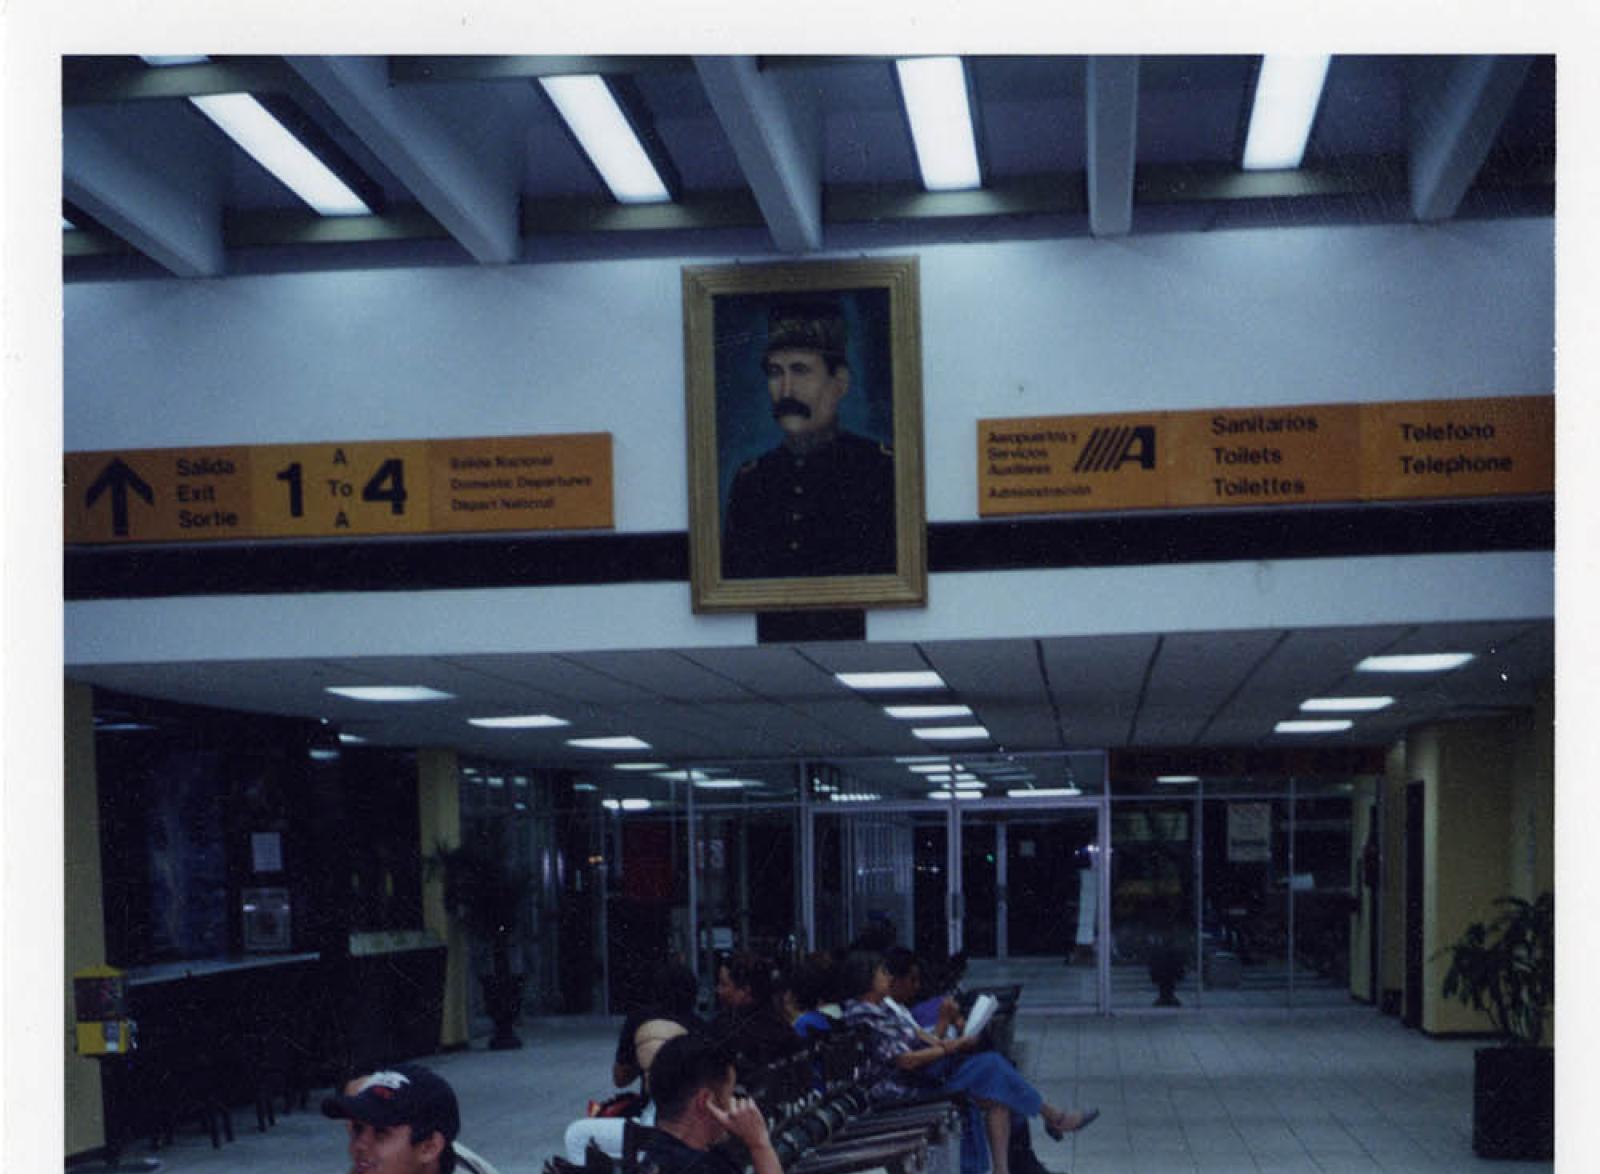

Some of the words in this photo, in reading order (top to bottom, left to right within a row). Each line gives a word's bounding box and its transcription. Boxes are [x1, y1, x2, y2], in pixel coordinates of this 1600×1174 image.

[1212, 416, 1319, 435] Sanitarios
[333, 447, 346, 465] A
[1212, 446, 1282, 465] Toilets
[176, 458, 235, 477] Salida
[1400, 454, 1514, 477] Telephone
[177, 485, 215, 502] Exit
[276, 462, 303, 518] 1
[327, 479, 354, 497] To
[362, 458, 407, 516] 4
[1213, 477, 1306, 497] Toilettes
[178, 510, 238, 529] Sortie
[335, 511, 350, 529] A
